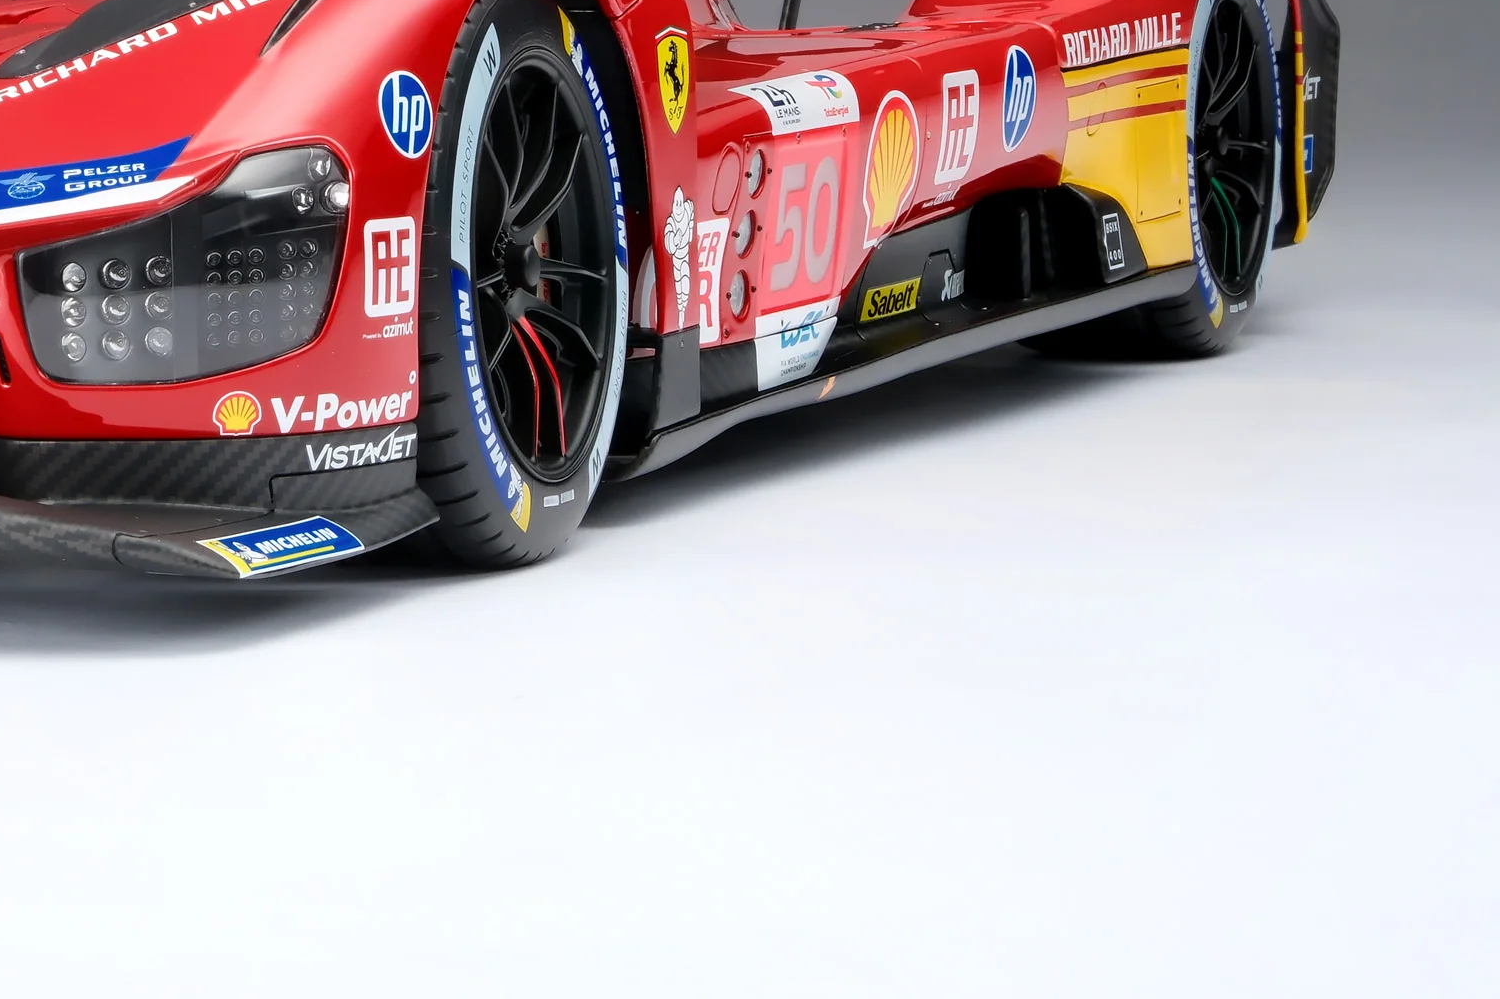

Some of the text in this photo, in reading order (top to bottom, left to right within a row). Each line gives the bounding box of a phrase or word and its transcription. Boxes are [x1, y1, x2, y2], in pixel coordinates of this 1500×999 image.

[1062, 11, 1182, 67] RICHARD MILLE
[392, 73, 425, 155] hp
[775, 109, 783, 119] LE
[1006, 50, 1033, 151] hp
[63, 163, 146, 179] PELZER
[64, 174, 148, 192] GROUP
[458, 124, 476, 243] PILOT SPORT
[584, 66, 629, 250] MICHELIN
[769, 155, 840, 292] 50
[1186, 156, 1212, 289] MICHELIN
[382, 316, 414, 339] azimut
[867, 282, 917, 318] Sabelt
[457, 288, 508, 478] MICHELIN
[270, 390, 412, 433] V-Power
[255, 527, 339, 555] MICHELIN
